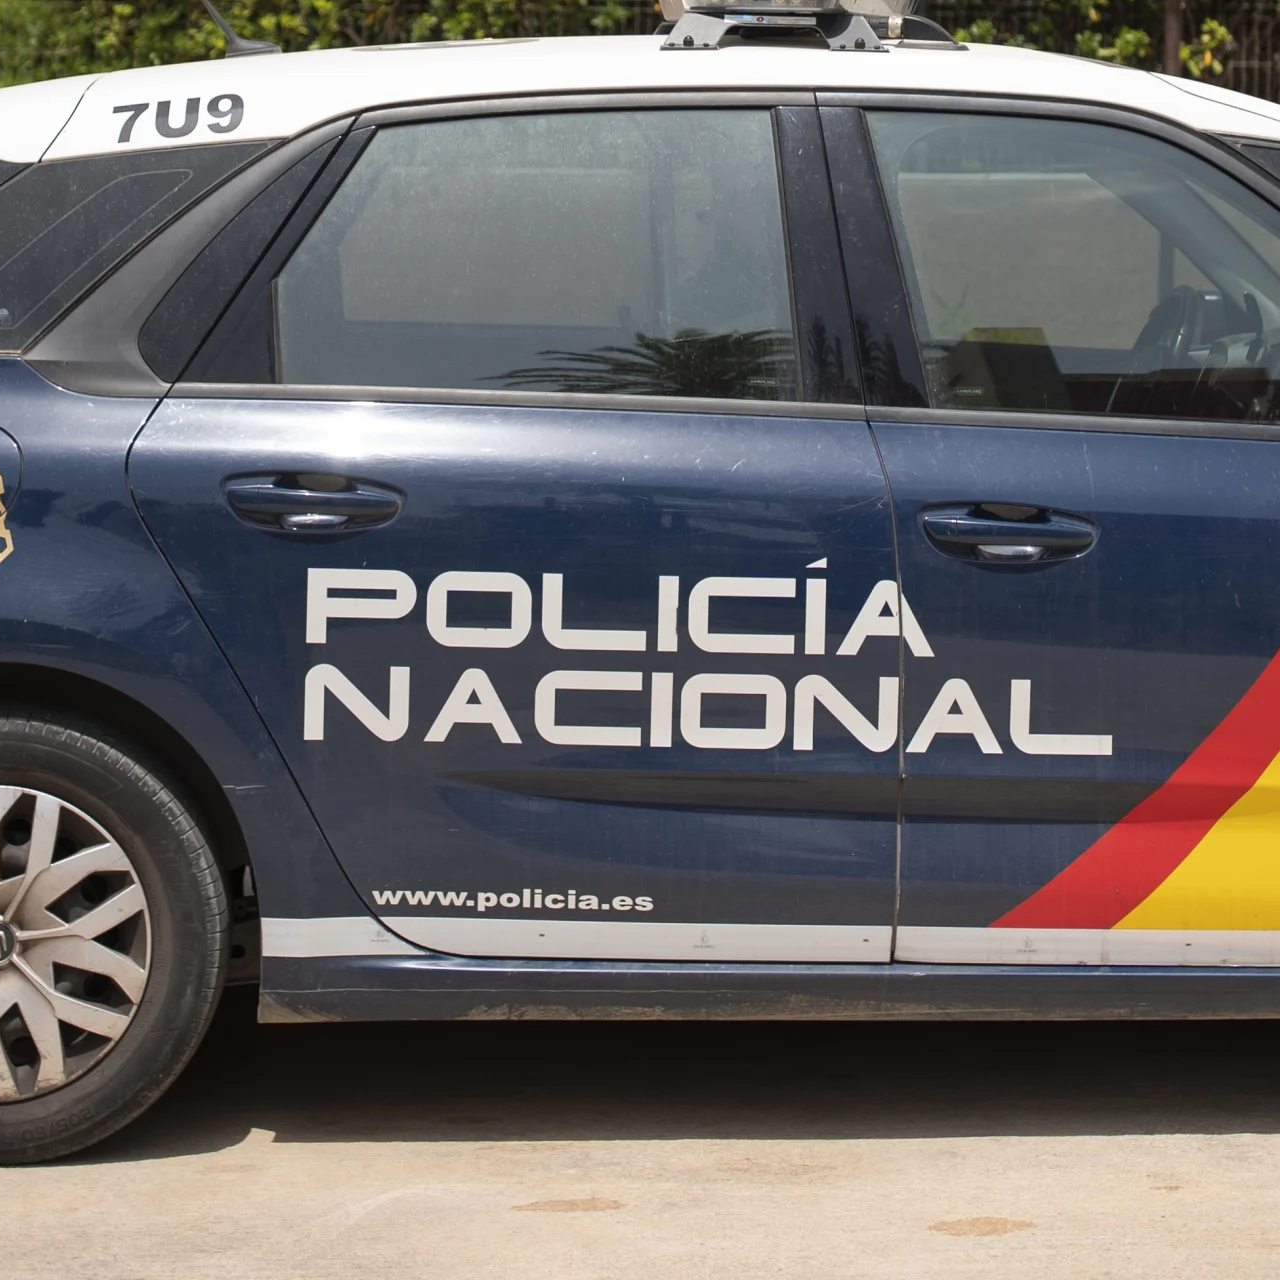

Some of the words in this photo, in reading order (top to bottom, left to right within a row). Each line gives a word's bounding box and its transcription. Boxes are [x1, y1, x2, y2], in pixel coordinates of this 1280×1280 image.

[112, 93, 245, 144] 7U9
[305, 557, 935, 658] POLICÍA
[303, 663, 1113, 756] NACIONAL
[371, 888, 655, 912] www.policia.es
